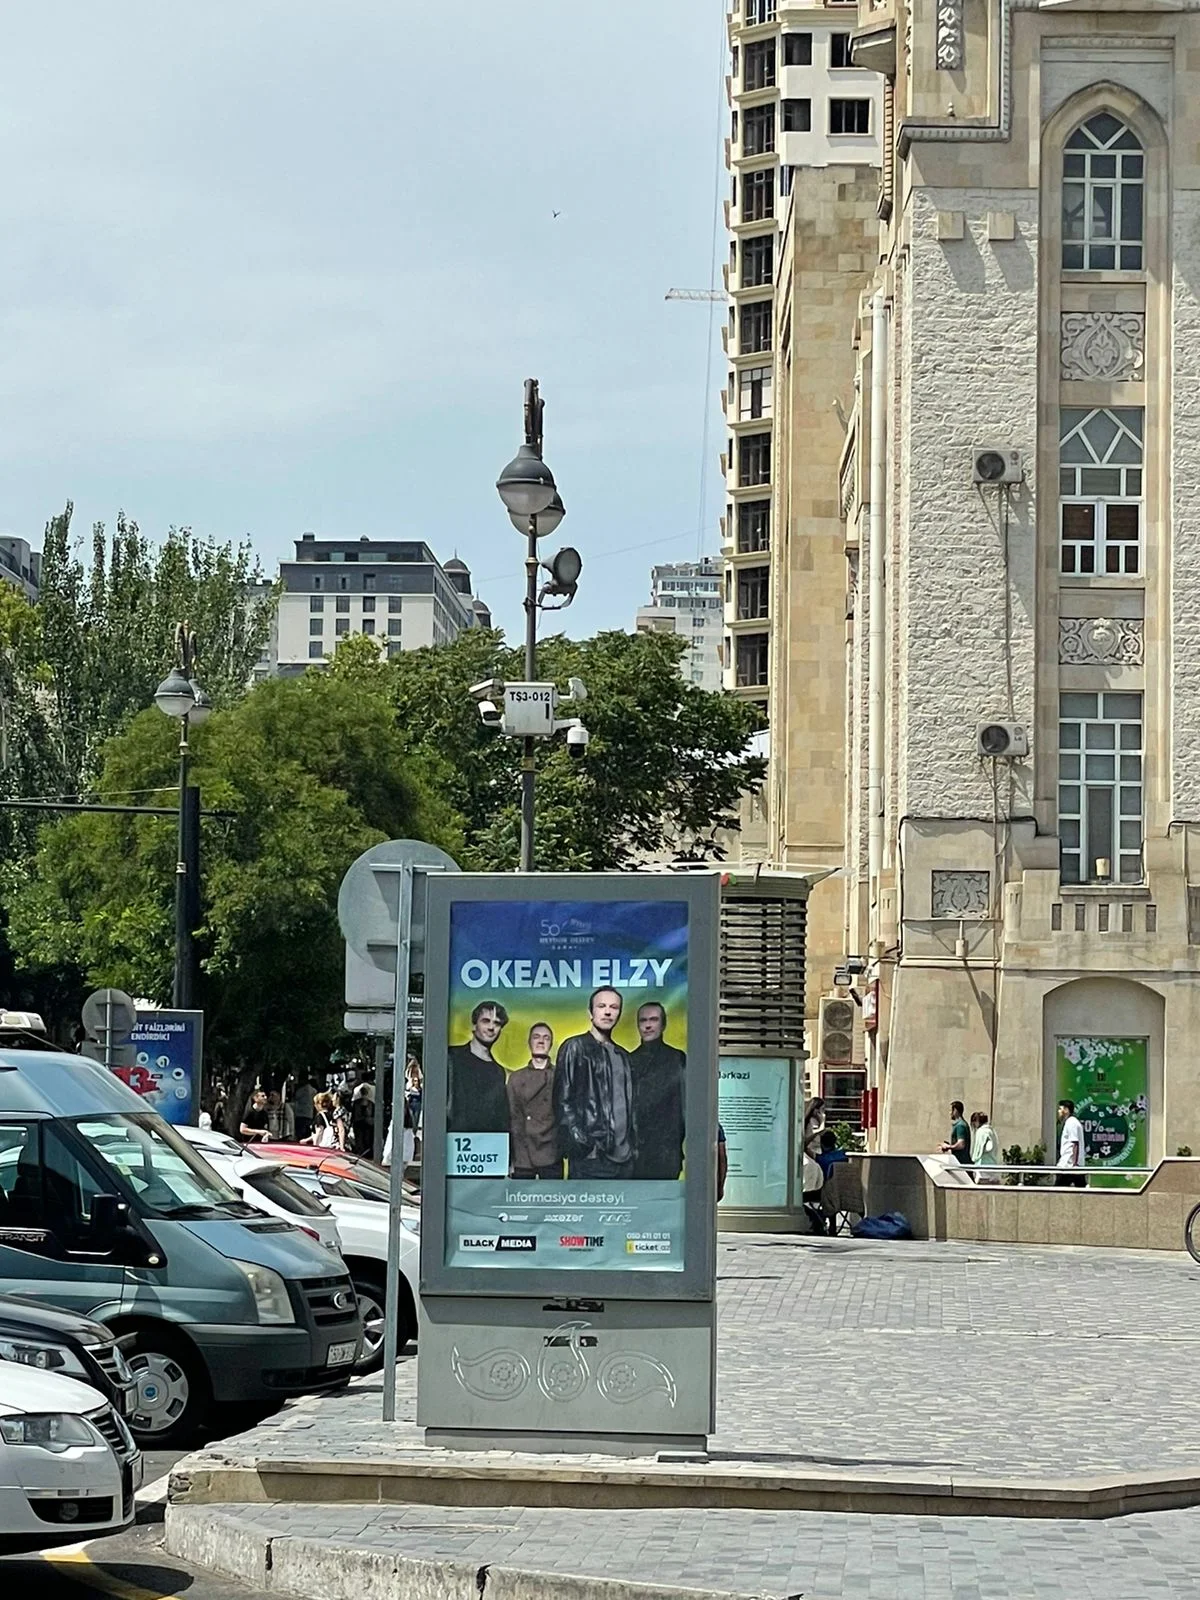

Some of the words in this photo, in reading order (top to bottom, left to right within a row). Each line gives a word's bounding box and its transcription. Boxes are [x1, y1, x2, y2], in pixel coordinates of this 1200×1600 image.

[460, 958, 582, 988] OKEAN
[592, 958, 673, 987] ELZY
[454, 1137, 472, 1151] 12
[456, 1153, 499, 1163] AVQUST
[456, 1164, 484, 1173] 19:00
[505, 1188, 577, 1206] İnformasiya
[579, 1191, 625, 1205] dəstəyi
[463, 1239, 495, 1248] BLACK
[501, 1238, 533, 1248] MEDIA
